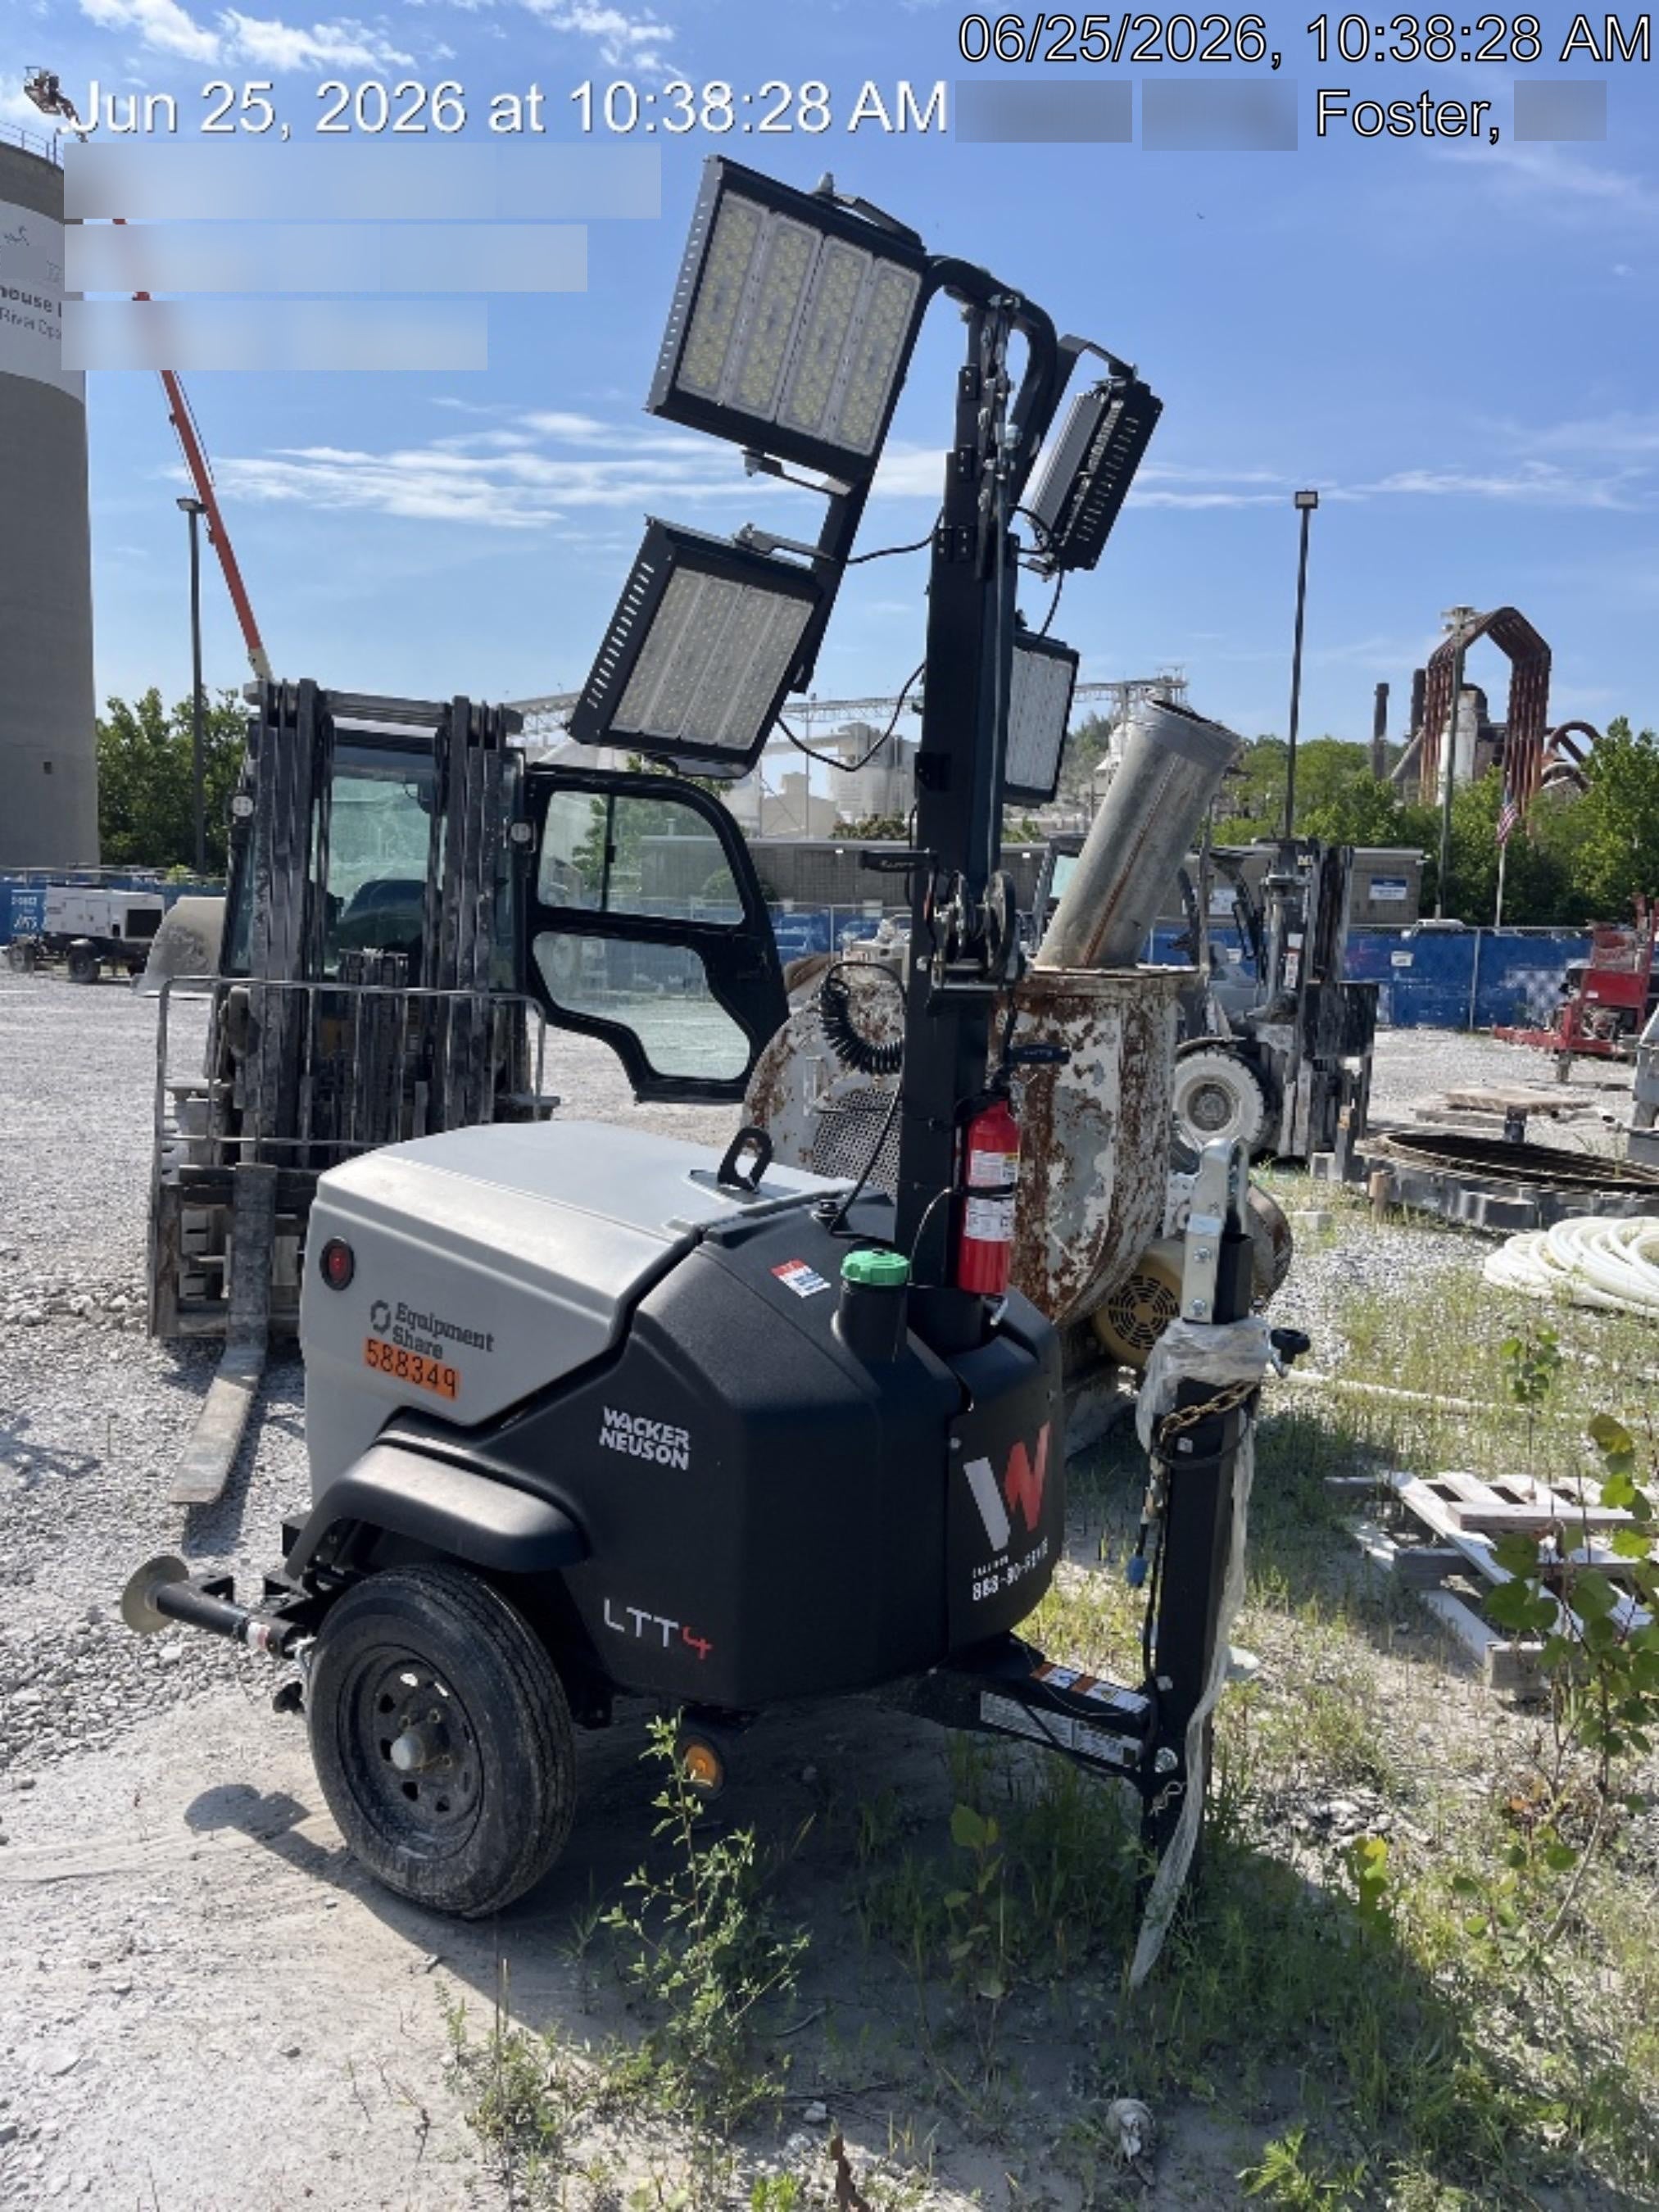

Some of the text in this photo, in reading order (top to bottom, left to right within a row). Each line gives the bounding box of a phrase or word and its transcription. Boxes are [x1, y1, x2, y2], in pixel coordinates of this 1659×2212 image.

[392, 1324, 443, 1359] Share
[395, 1301, 495, 1353] Equipment
[366, 1338, 456, 1398] 588349
[599, 1426, 690, 1471] NEUSON
[603, 1405, 691, 1452] WACKER
[604, 1597, 713, 1661] LTT4
